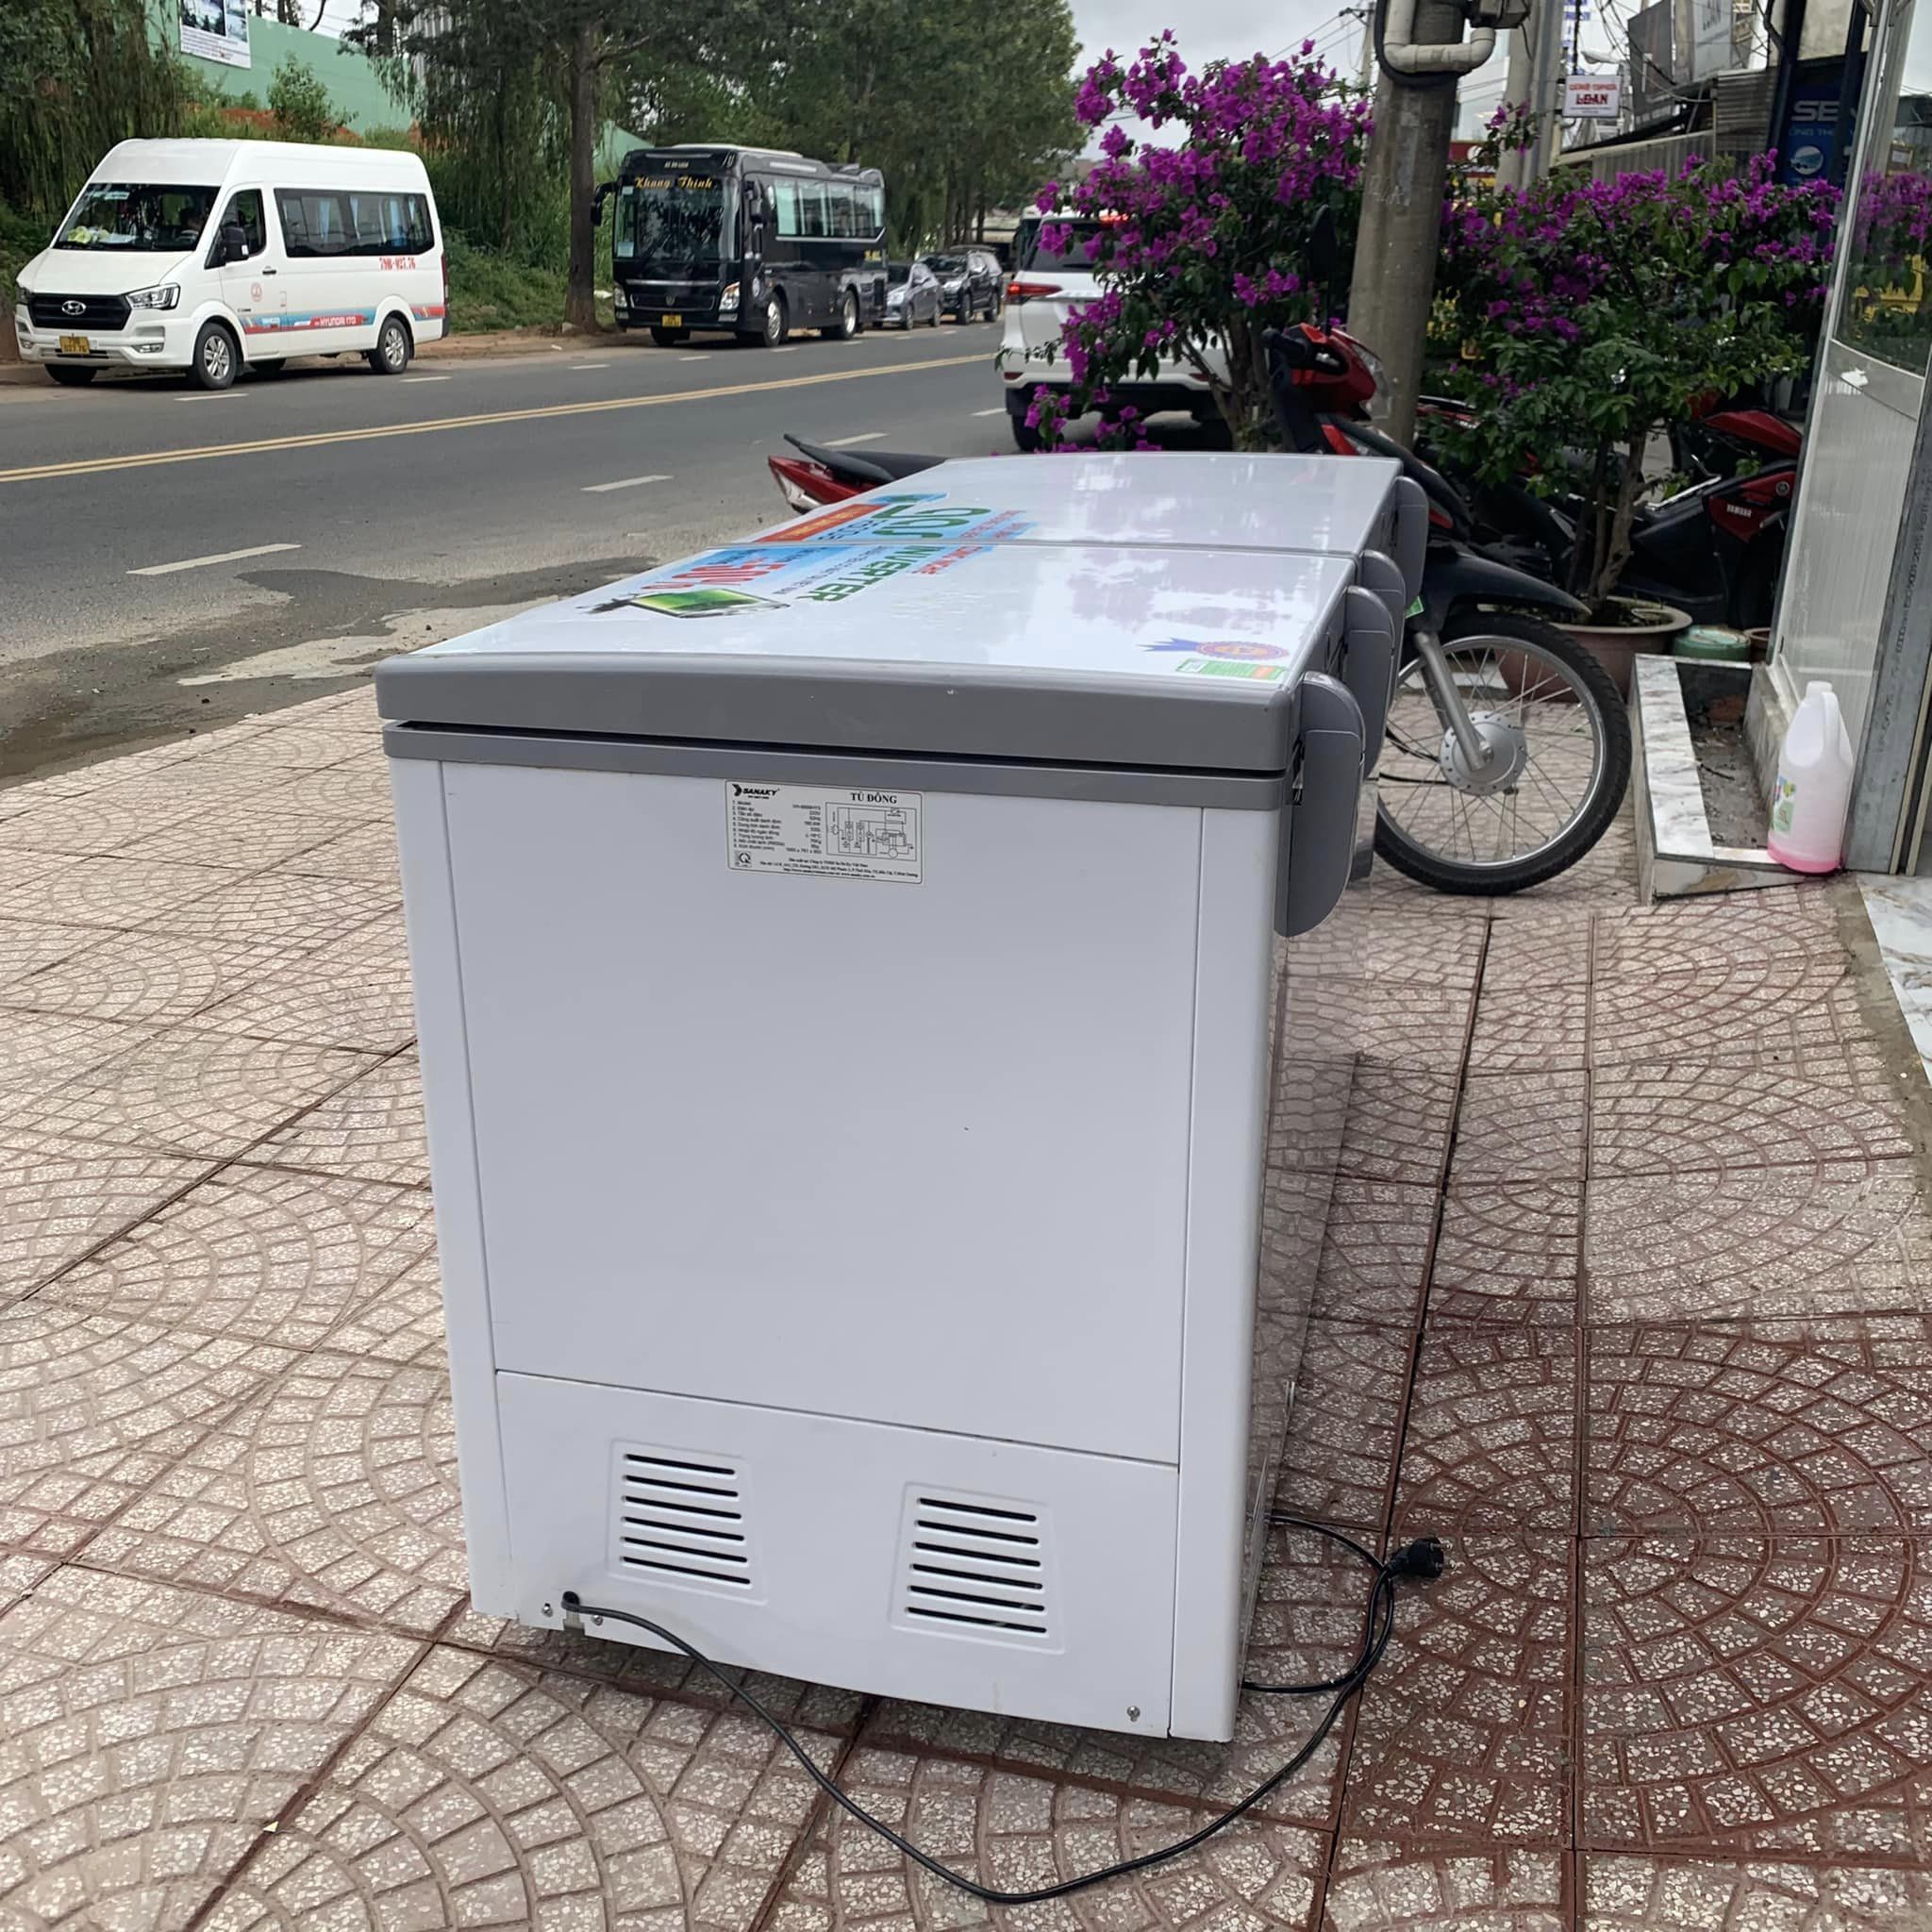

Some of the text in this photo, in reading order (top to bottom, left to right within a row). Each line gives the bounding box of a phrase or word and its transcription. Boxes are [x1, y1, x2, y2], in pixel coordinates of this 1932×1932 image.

[1791, 100, 1841, 122] SE
[796, 545, 945, 602] INVERTER
[743, 788, 777, 796] SANAKY
[850, 791, 897, 805] TỦ ĐÔNG
